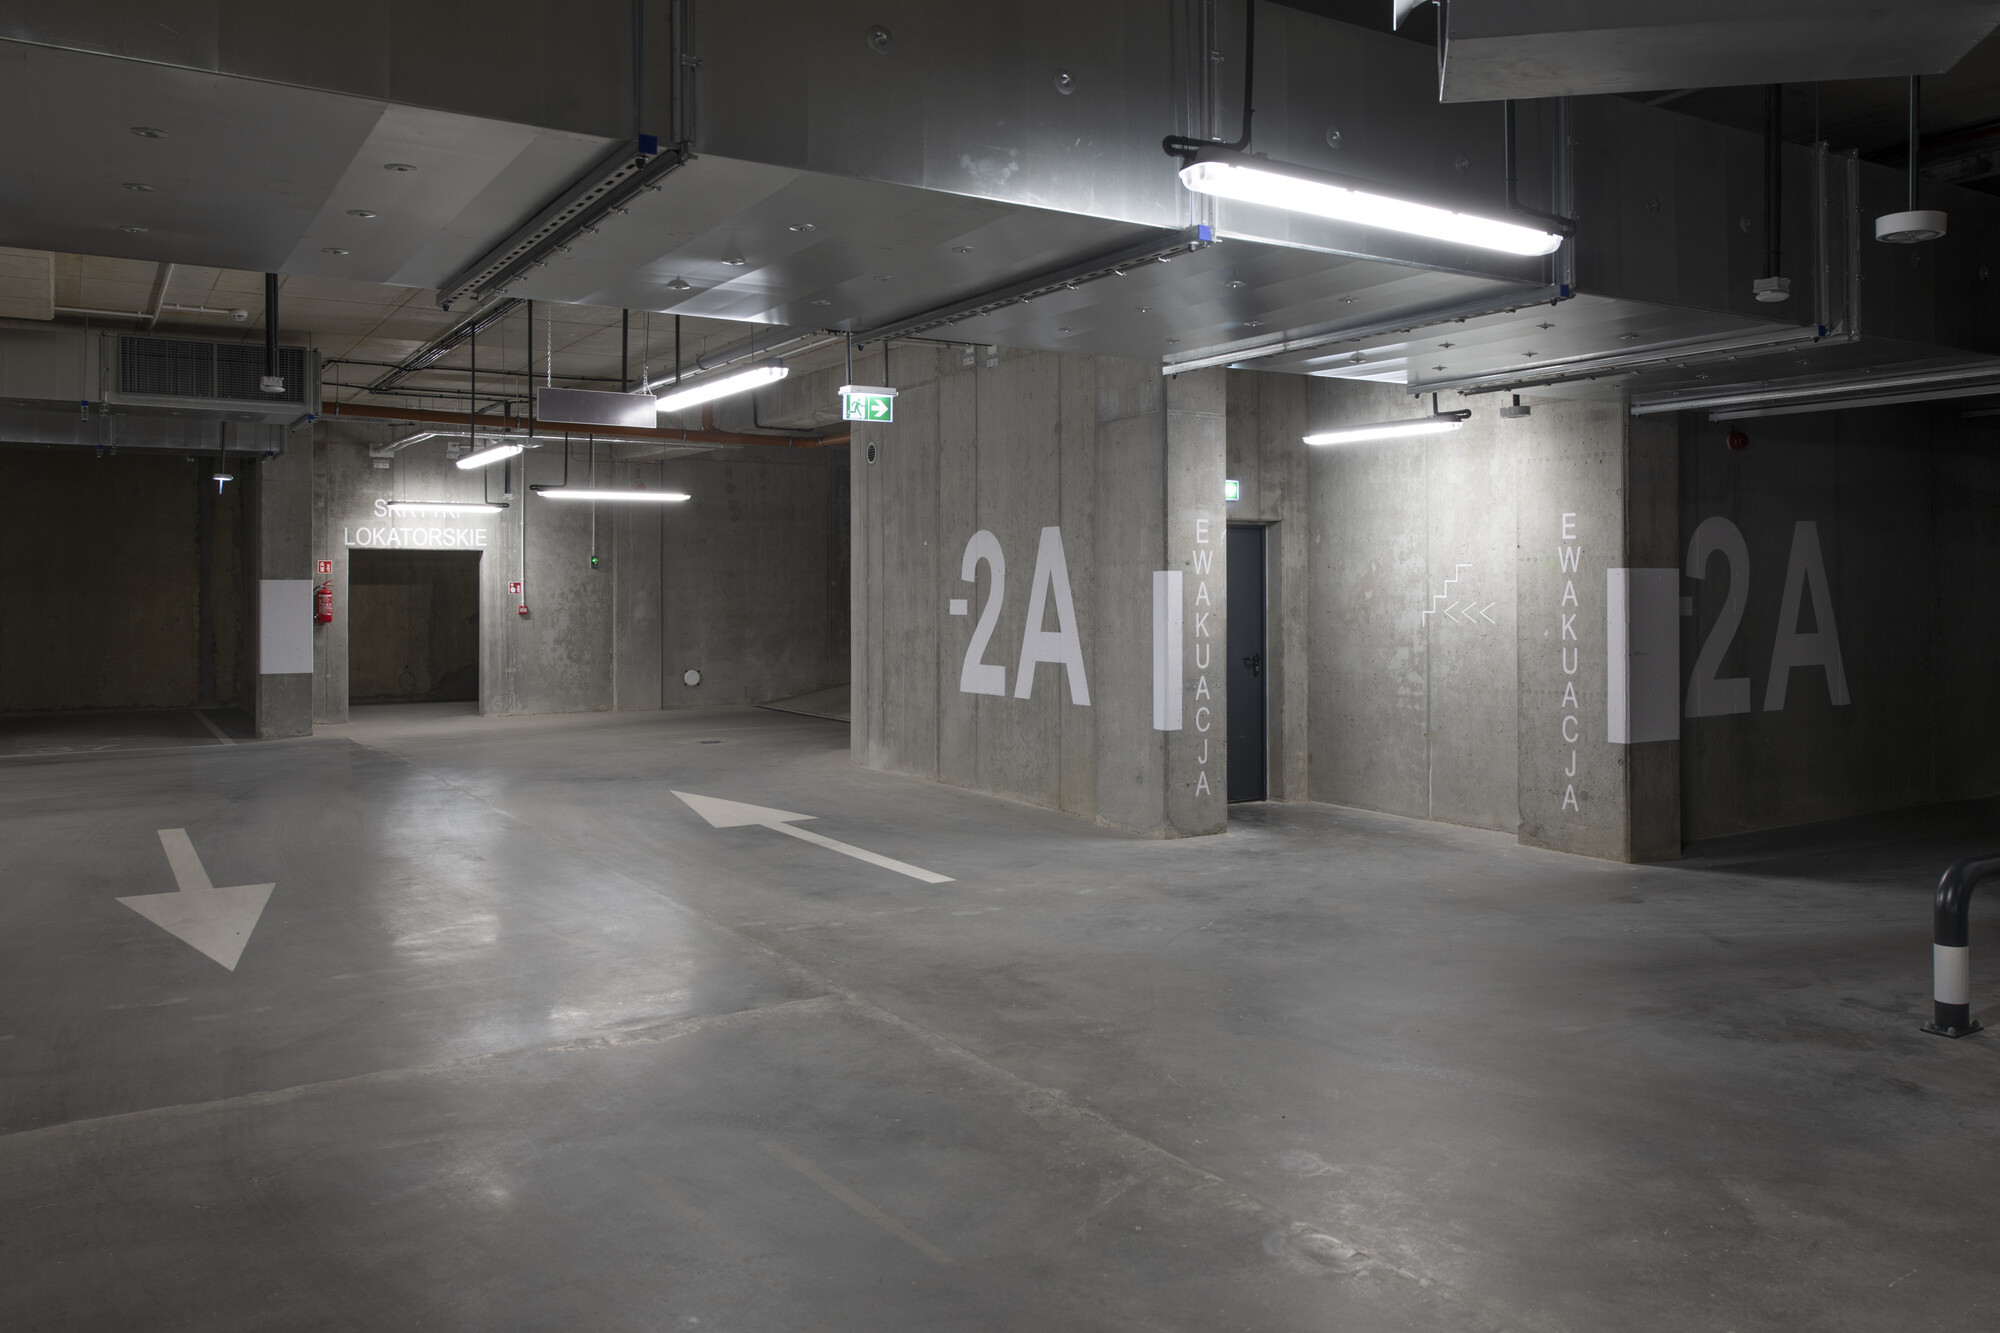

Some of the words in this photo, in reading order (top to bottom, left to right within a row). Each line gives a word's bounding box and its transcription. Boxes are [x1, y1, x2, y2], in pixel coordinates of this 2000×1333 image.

[344, 527, 488, 546] LOKATORSKIE
[1192, 518, 1214, 798] EWAKUACJA
[1557, 512, 1581, 812] EWAKUACJA
